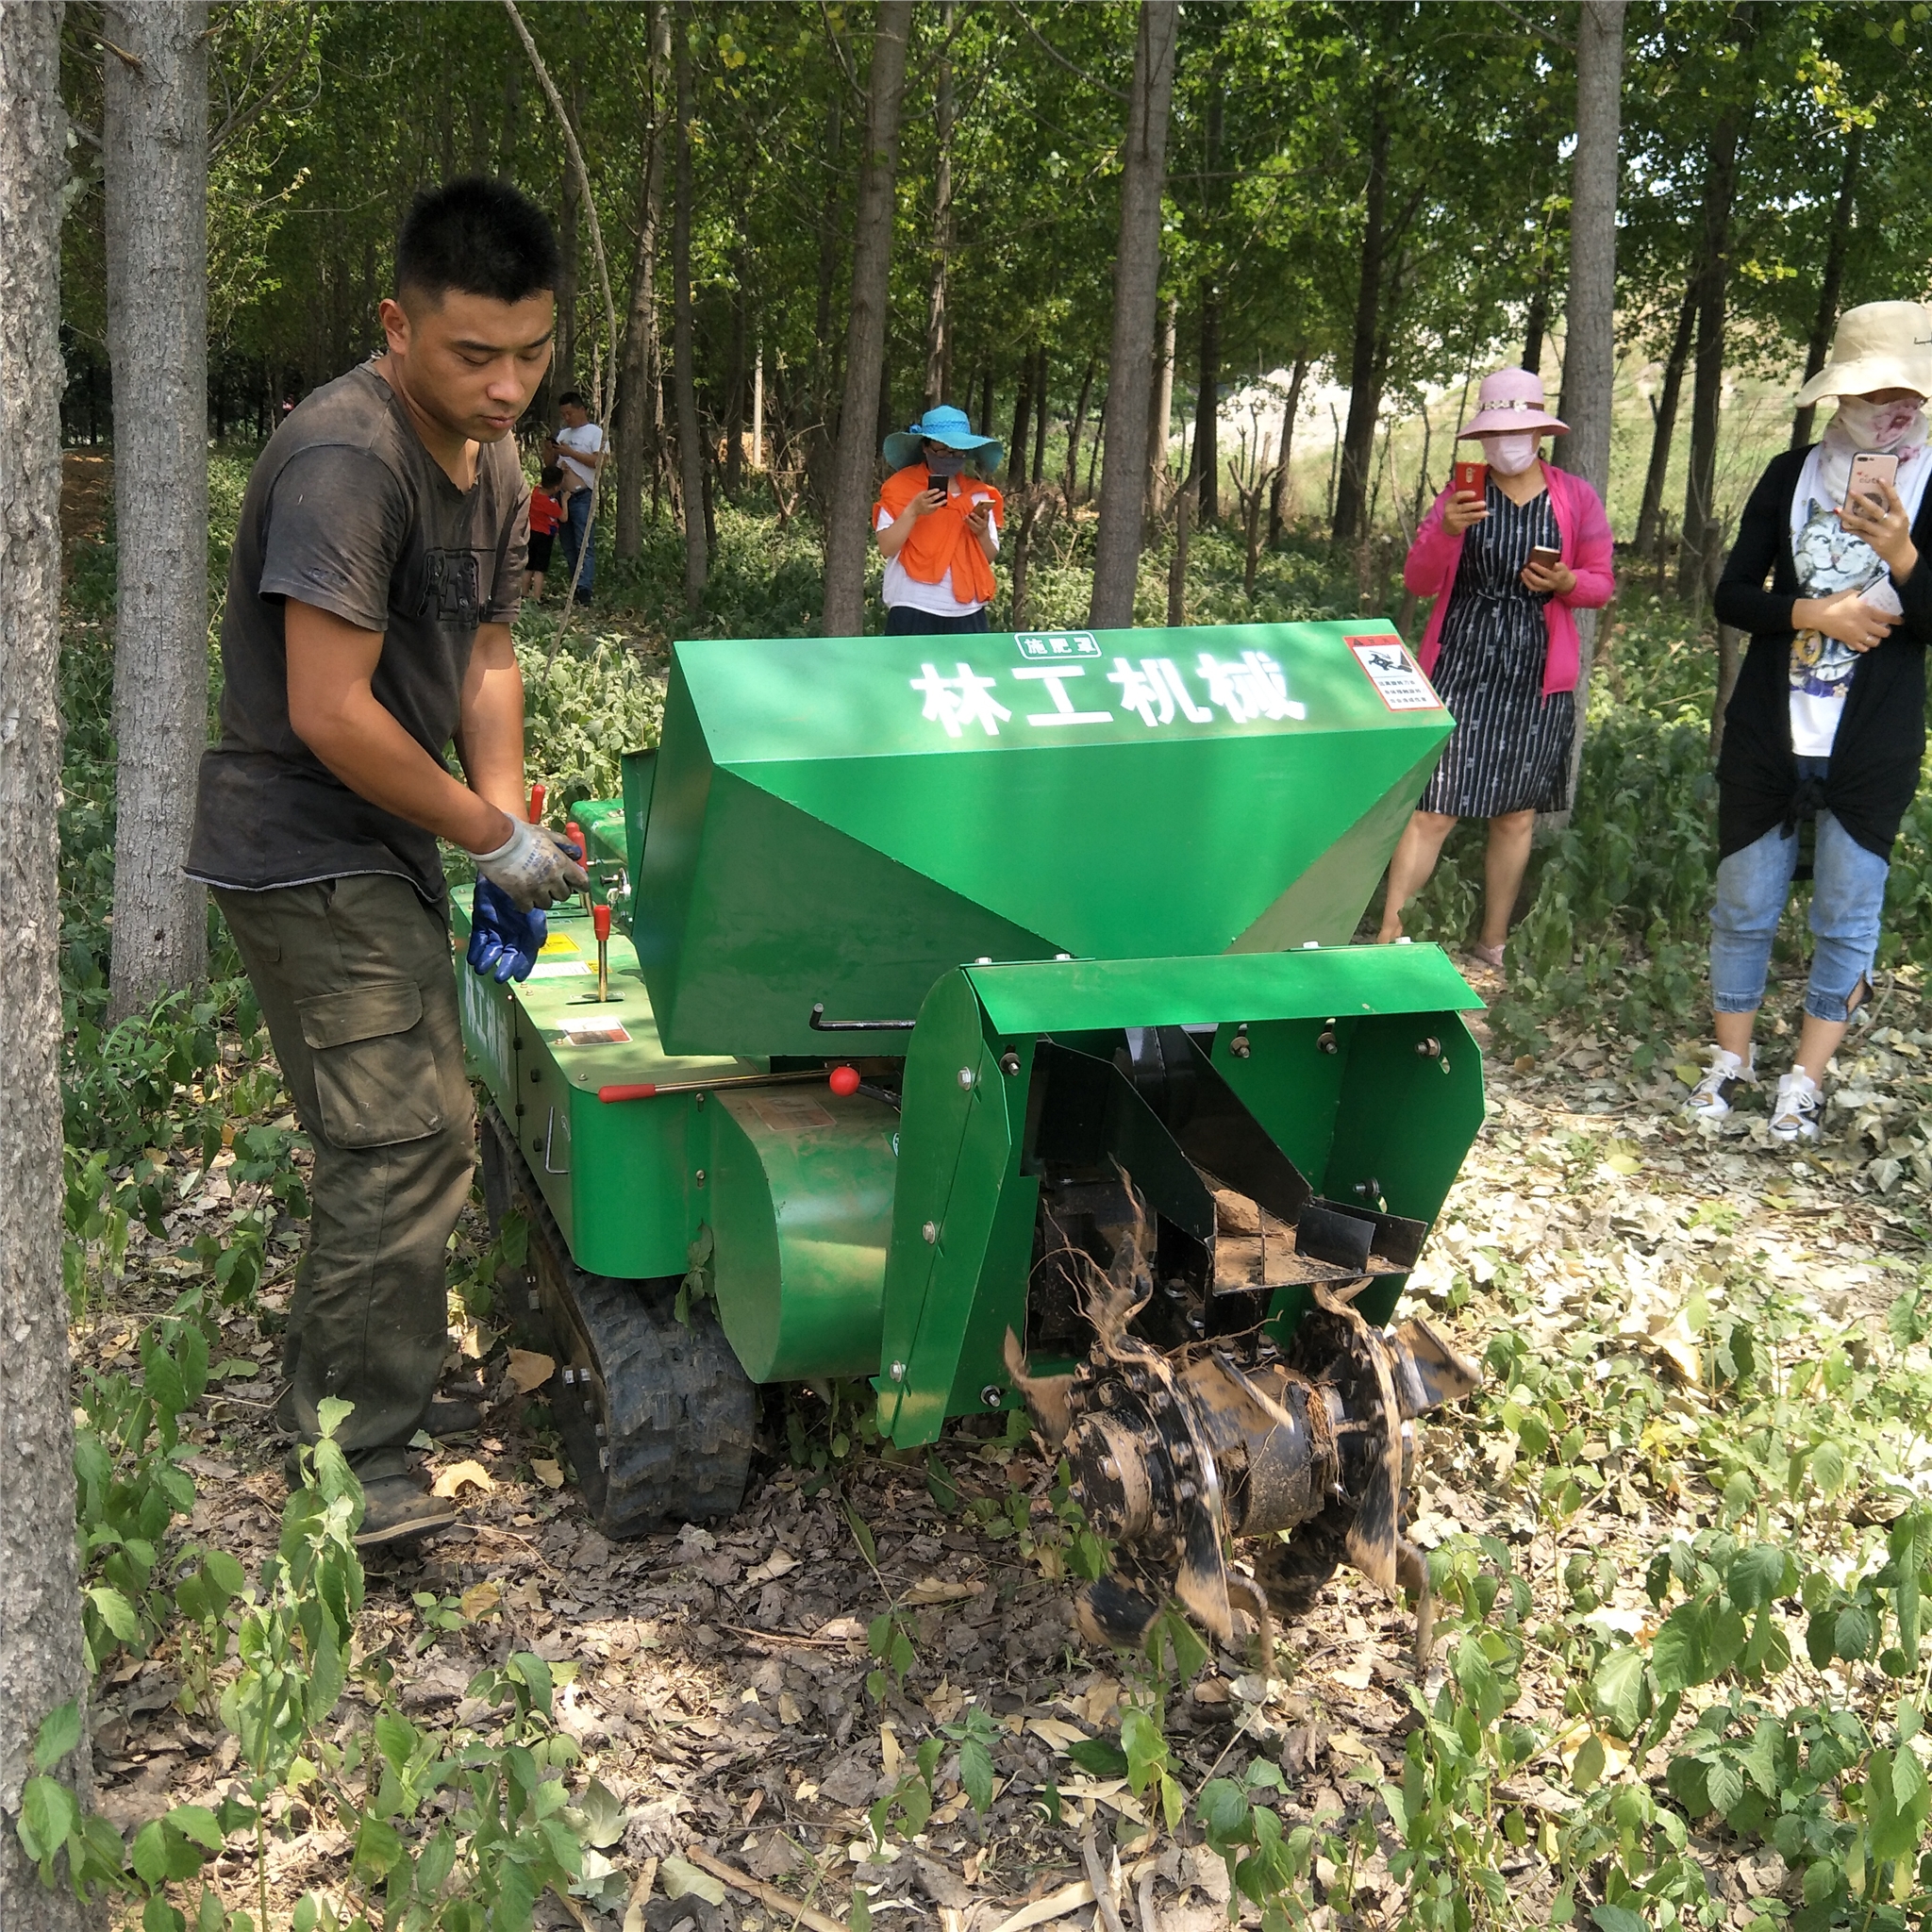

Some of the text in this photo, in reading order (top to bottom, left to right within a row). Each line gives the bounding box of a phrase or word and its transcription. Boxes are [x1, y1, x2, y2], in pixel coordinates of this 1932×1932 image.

[1024, 637, 1096, 655] 施肥罩
[910, 651, 1306, 738] 林工机械
